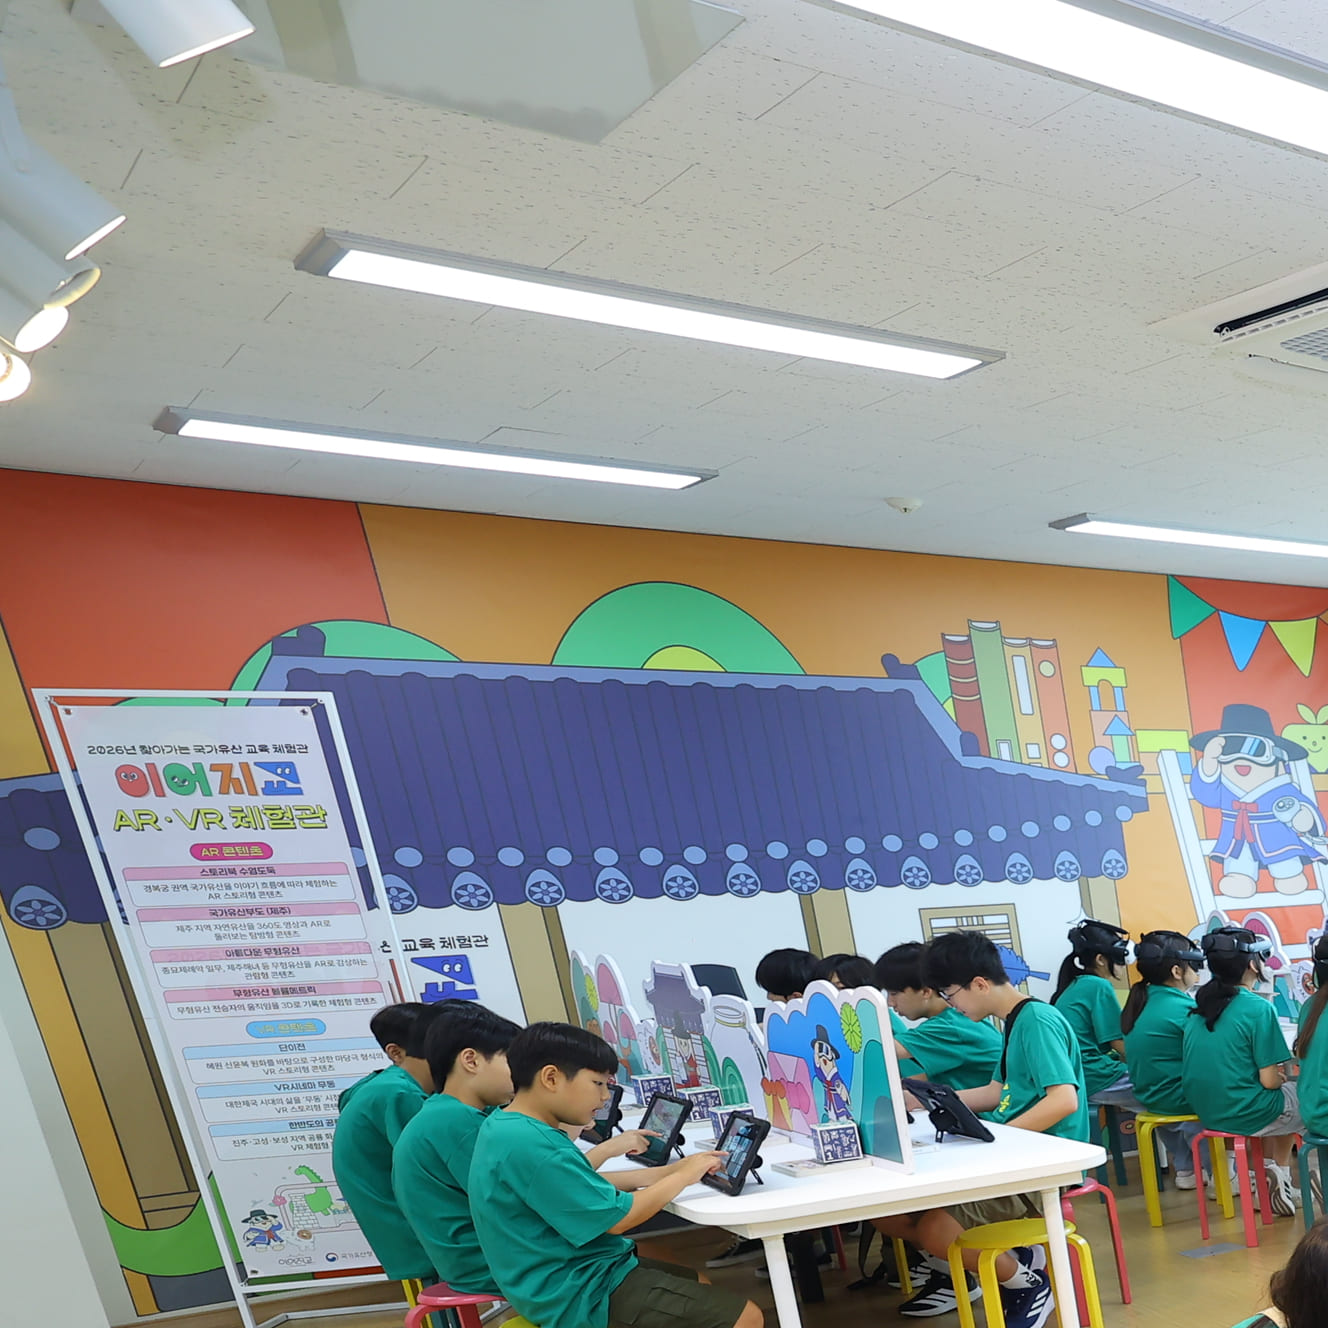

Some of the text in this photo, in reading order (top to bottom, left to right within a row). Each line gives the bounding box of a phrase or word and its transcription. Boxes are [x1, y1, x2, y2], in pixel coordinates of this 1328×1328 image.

[87, 743, 309, 756] 2026년 찾아가는 국가유산 교육 체험관
[115, 761, 304, 798] 이어지교
[228, 804, 328, 830] 체험관
[201, 846, 264, 857] AR 콘텐츠
[200, 867, 238, 876] 스토리북
[143, 884, 169, 893] 경복궁
[190, 882, 232, 892] 국가유산을
[234, 881, 260, 890] 이야기
[287, 880, 304, 889] 따라
[305, 879, 338, 889] 체험하는
[208, 890, 284, 900] AR 스토리형 콘텐츠
[266, 907, 291, 916] (제주)
[176, 924, 194, 933] 제주
[257, 922, 282, 930] 360도
[310, 920, 331, 928] AR로
[276, 930, 301, 939] 콘텐츠
[401, 937, 436, 952] 교육
[439, 935, 489, 949] 체험관
[264, 946, 301, 956] 무형유산
[314, 960, 336, 968] AR로
[271, 970, 296, 979] 콘텐츠
[233, 987, 270, 998] 무형유산
[177, 1005, 211, 1015] 무형유산
[281, 1000, 302, 1010] 3D로
[353, 997, 378, 1006] 콘텐츠
[278, 1043, 306, 1052] 단이전
[310, 1055, 333, 1064] 구성한
[263, 1067, 276, 1075] VR
[311, 1064, 335, 1073] 콘텐츠
[317, 1080, 336, 1089] 무동
[275, 1106, 288, 1114] VR
[321, 1103, 339, 1112] 콘텐
[288, 1120, 324, 1129] 한반도의
[291, 1144, 304, 1152] VR
